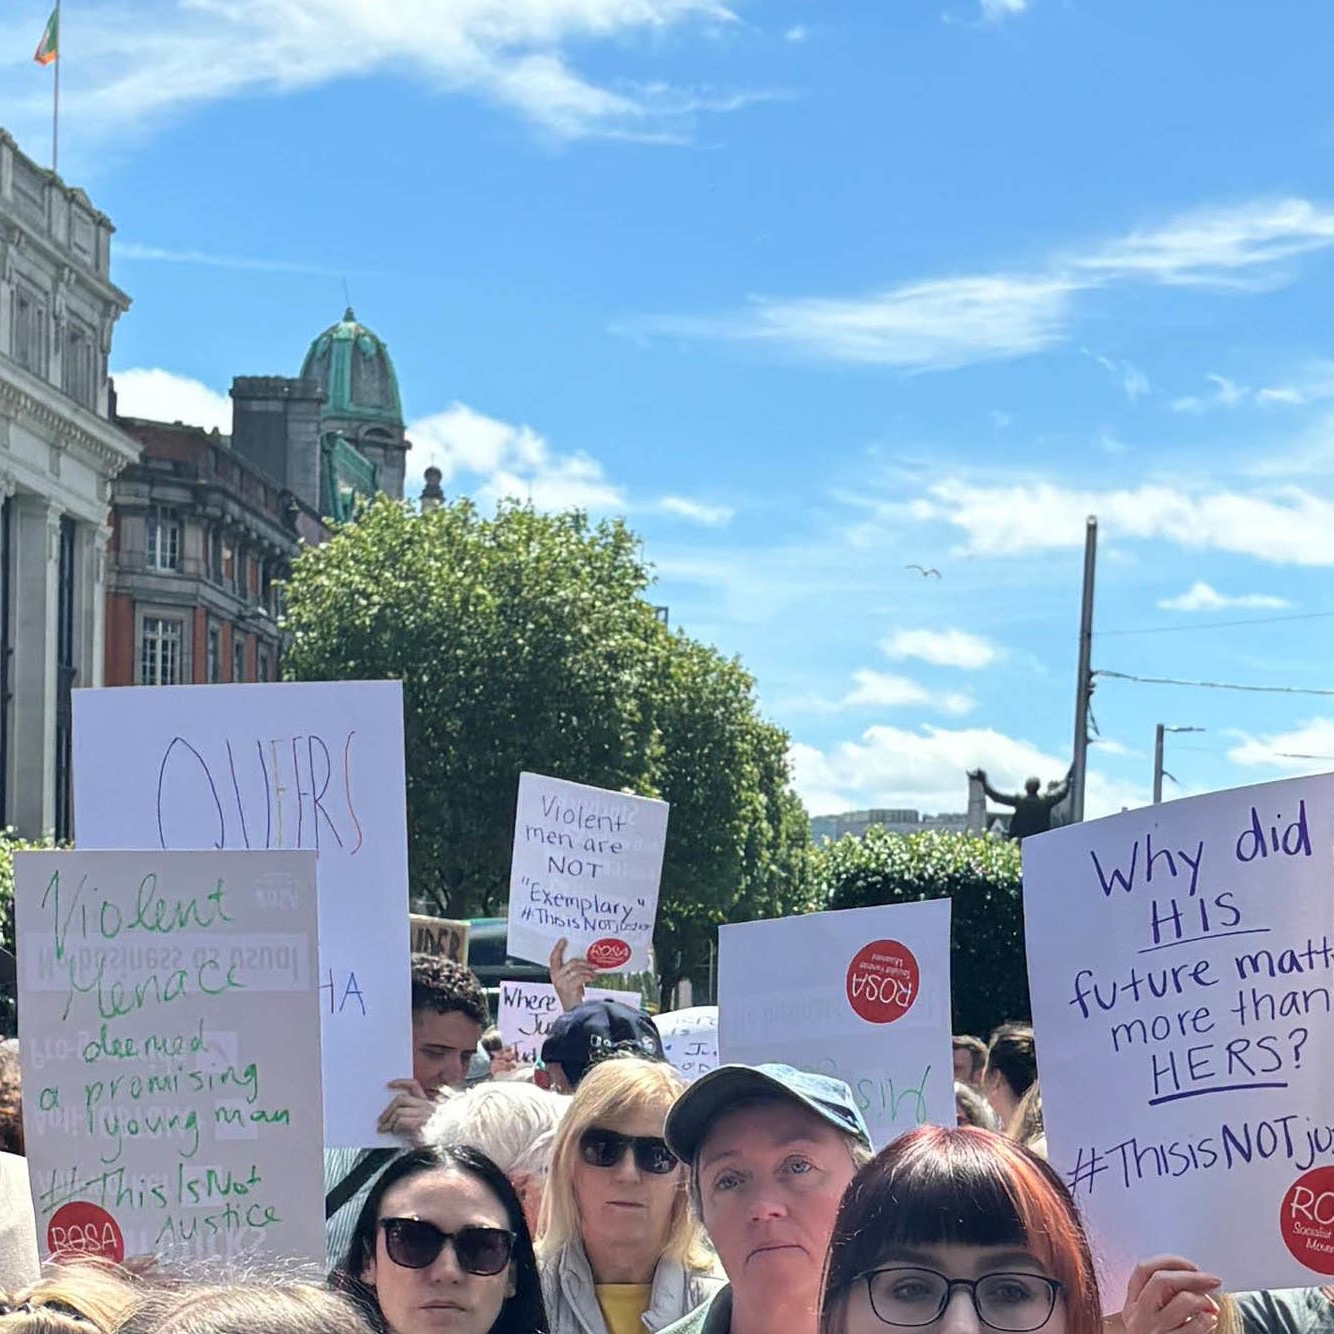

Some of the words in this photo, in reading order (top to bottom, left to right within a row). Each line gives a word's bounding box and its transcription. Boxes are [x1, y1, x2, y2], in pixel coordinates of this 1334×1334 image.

[526, 825, 574, 849] men
[583, 838, 623, 854] are
[542, 795, 627, 832] Violent
[548, 856, 605, 879] NOT
[1090, 833, 1204, 897] Why
[1235, 800, 1313, 862] did
[42, 869, 234, 959] Violent
[1150, 892, 1241, 944] HIS
[852, 973, 913, 1008] ROSA
[1068, 960, 1220, 1019] future
[1235, 936, 1334, 980] matt
[83, 1018, 209, 1064] deemed
[1111, 1006, 1216, 1052] more
[1231, 987, 1331, 1027] than
[1151, 1027, 1308, 1095] HERS?
[39, 1086, 59, 1111] a
[85, 1062, 259, 1134] promising
[101, 1110, 199, 1164] young
[216, 1105, 290, 1127] man
[51, 1222, 118, 1252] ROSA
